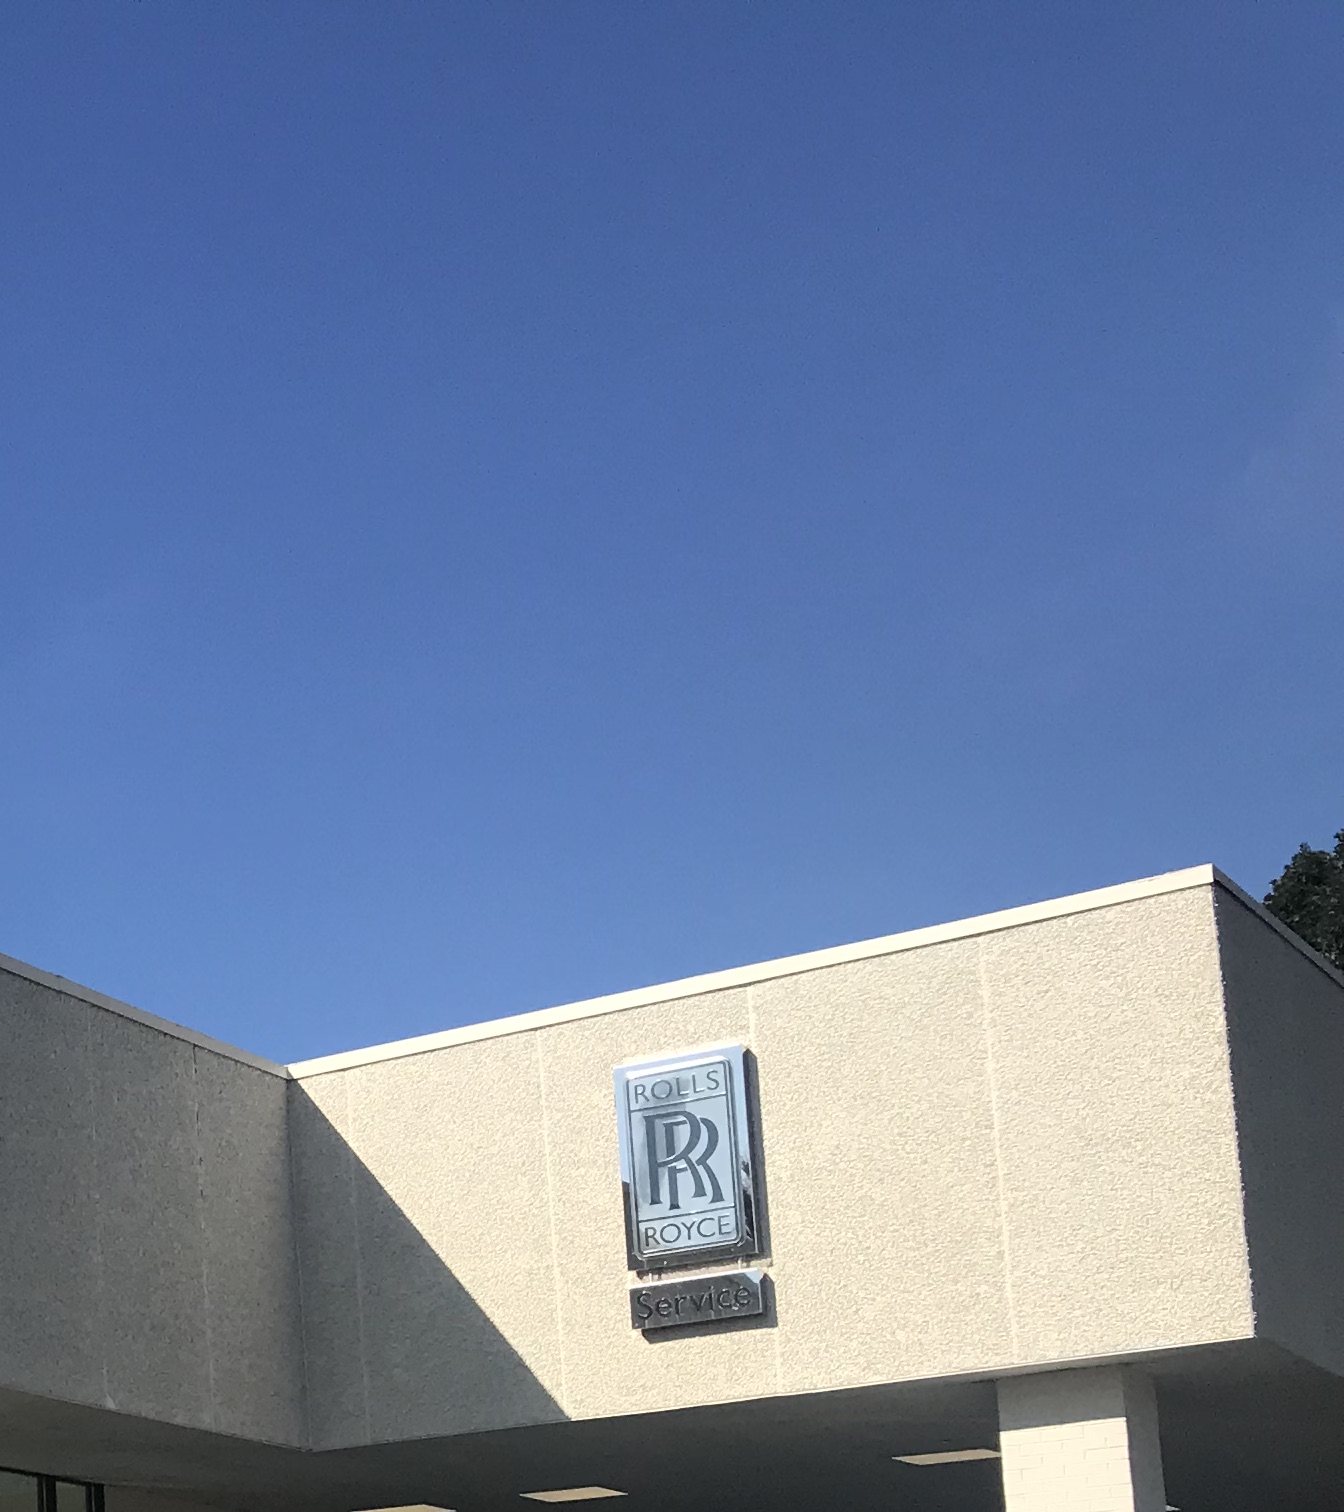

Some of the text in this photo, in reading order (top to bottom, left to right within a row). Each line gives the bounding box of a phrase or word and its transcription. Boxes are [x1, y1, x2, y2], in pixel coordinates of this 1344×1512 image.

[634, 1069, 721, 1104] ROLLS
[644, 1213, 734, 1248] ROYCE
[635, 1284, 752, 1323] Service
